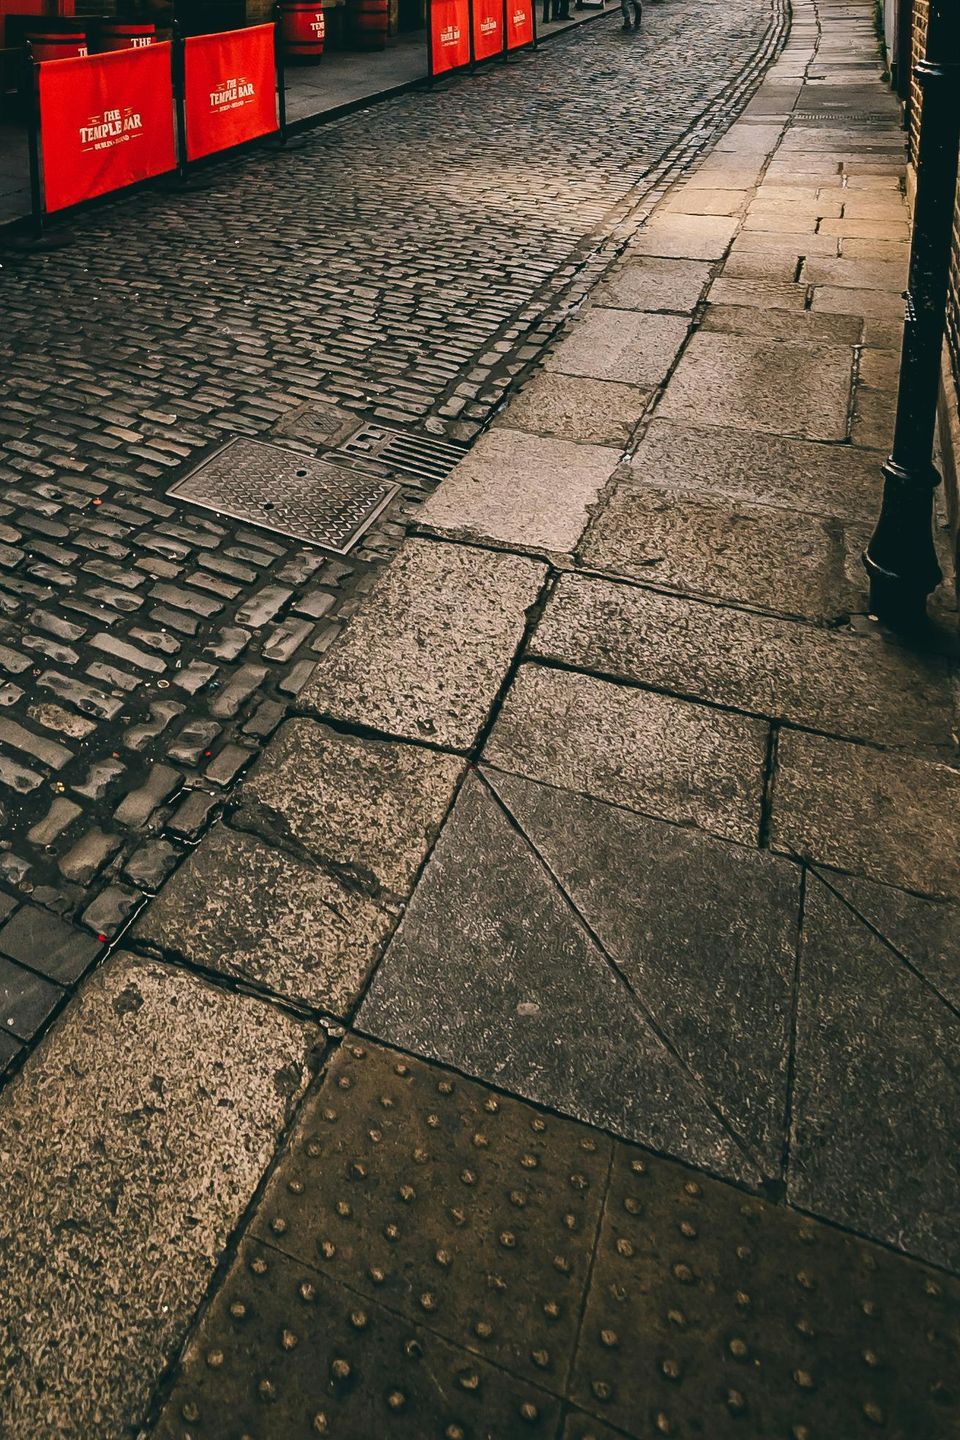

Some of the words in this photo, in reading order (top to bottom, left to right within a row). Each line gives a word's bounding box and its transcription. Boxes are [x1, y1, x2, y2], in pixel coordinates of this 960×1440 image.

[210, 88, 237, 106] TEMPLE
[238, 83, 255, 98] BAR
[104, 109, 121, 122] THE
[80, 120, 122, 143] TEMPLE
